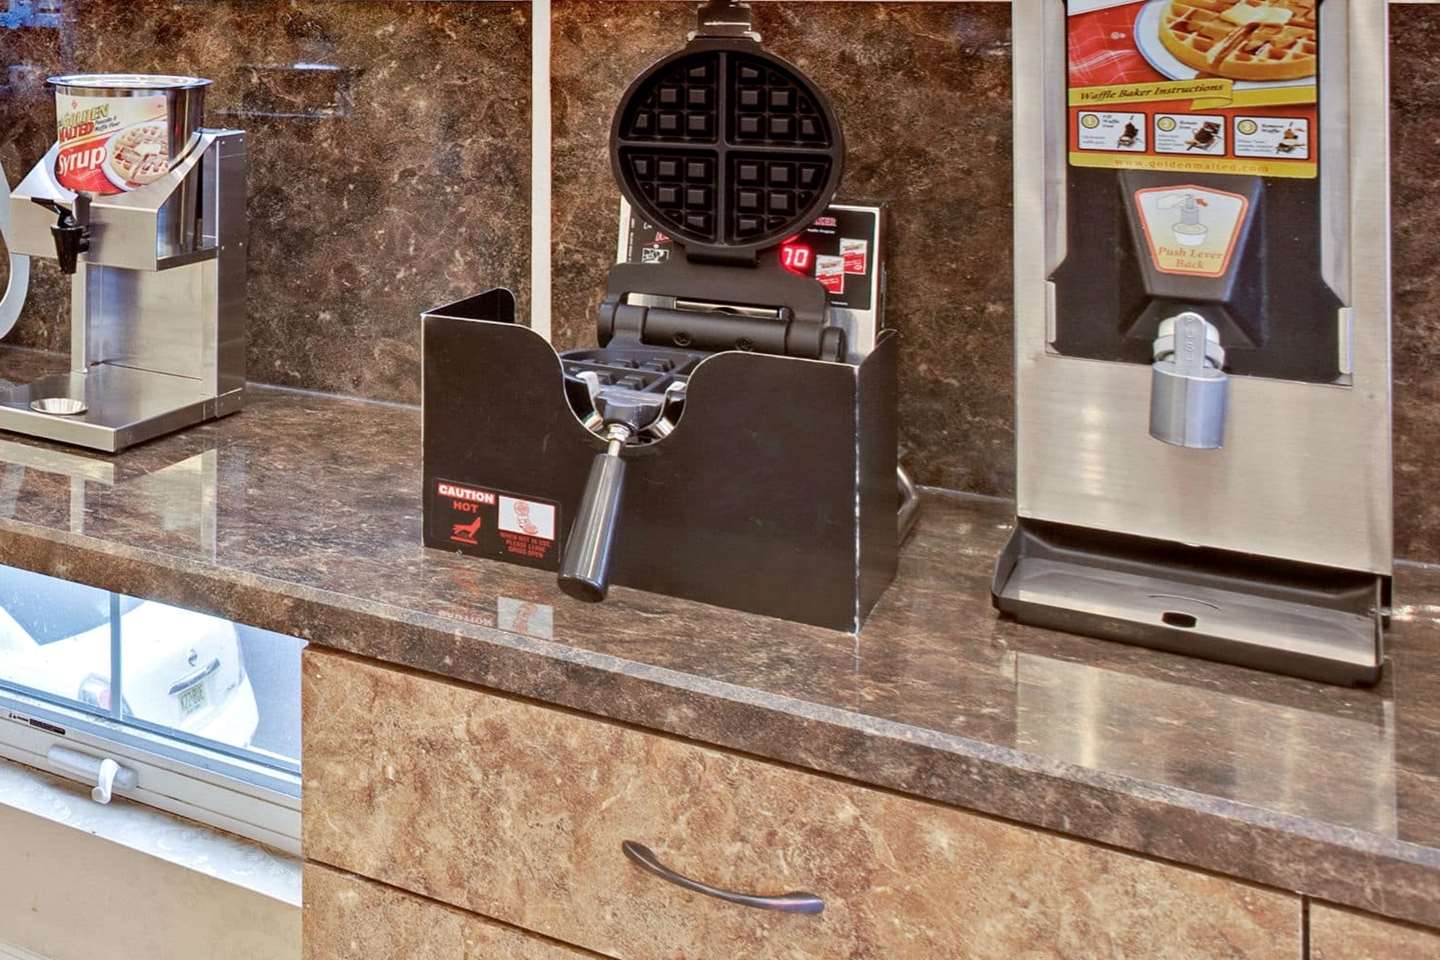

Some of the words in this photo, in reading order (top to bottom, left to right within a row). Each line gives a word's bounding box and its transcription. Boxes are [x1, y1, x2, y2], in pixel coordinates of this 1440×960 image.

[1080, 89, 1116, 100] Waffle
[1118, 88, 1151, 98] Baker
[1154, 83, 1225, 95] Instructions
[58, 146, 107, 177] Syrup
[1158, 246, 1187, 257] Push
[1190, 248, 1223, 259] Lever
[1175, 258, 1205, 269] Back
[438, 484, 496, 504] CAUTION
[452, 502, 479, 513] HOT
